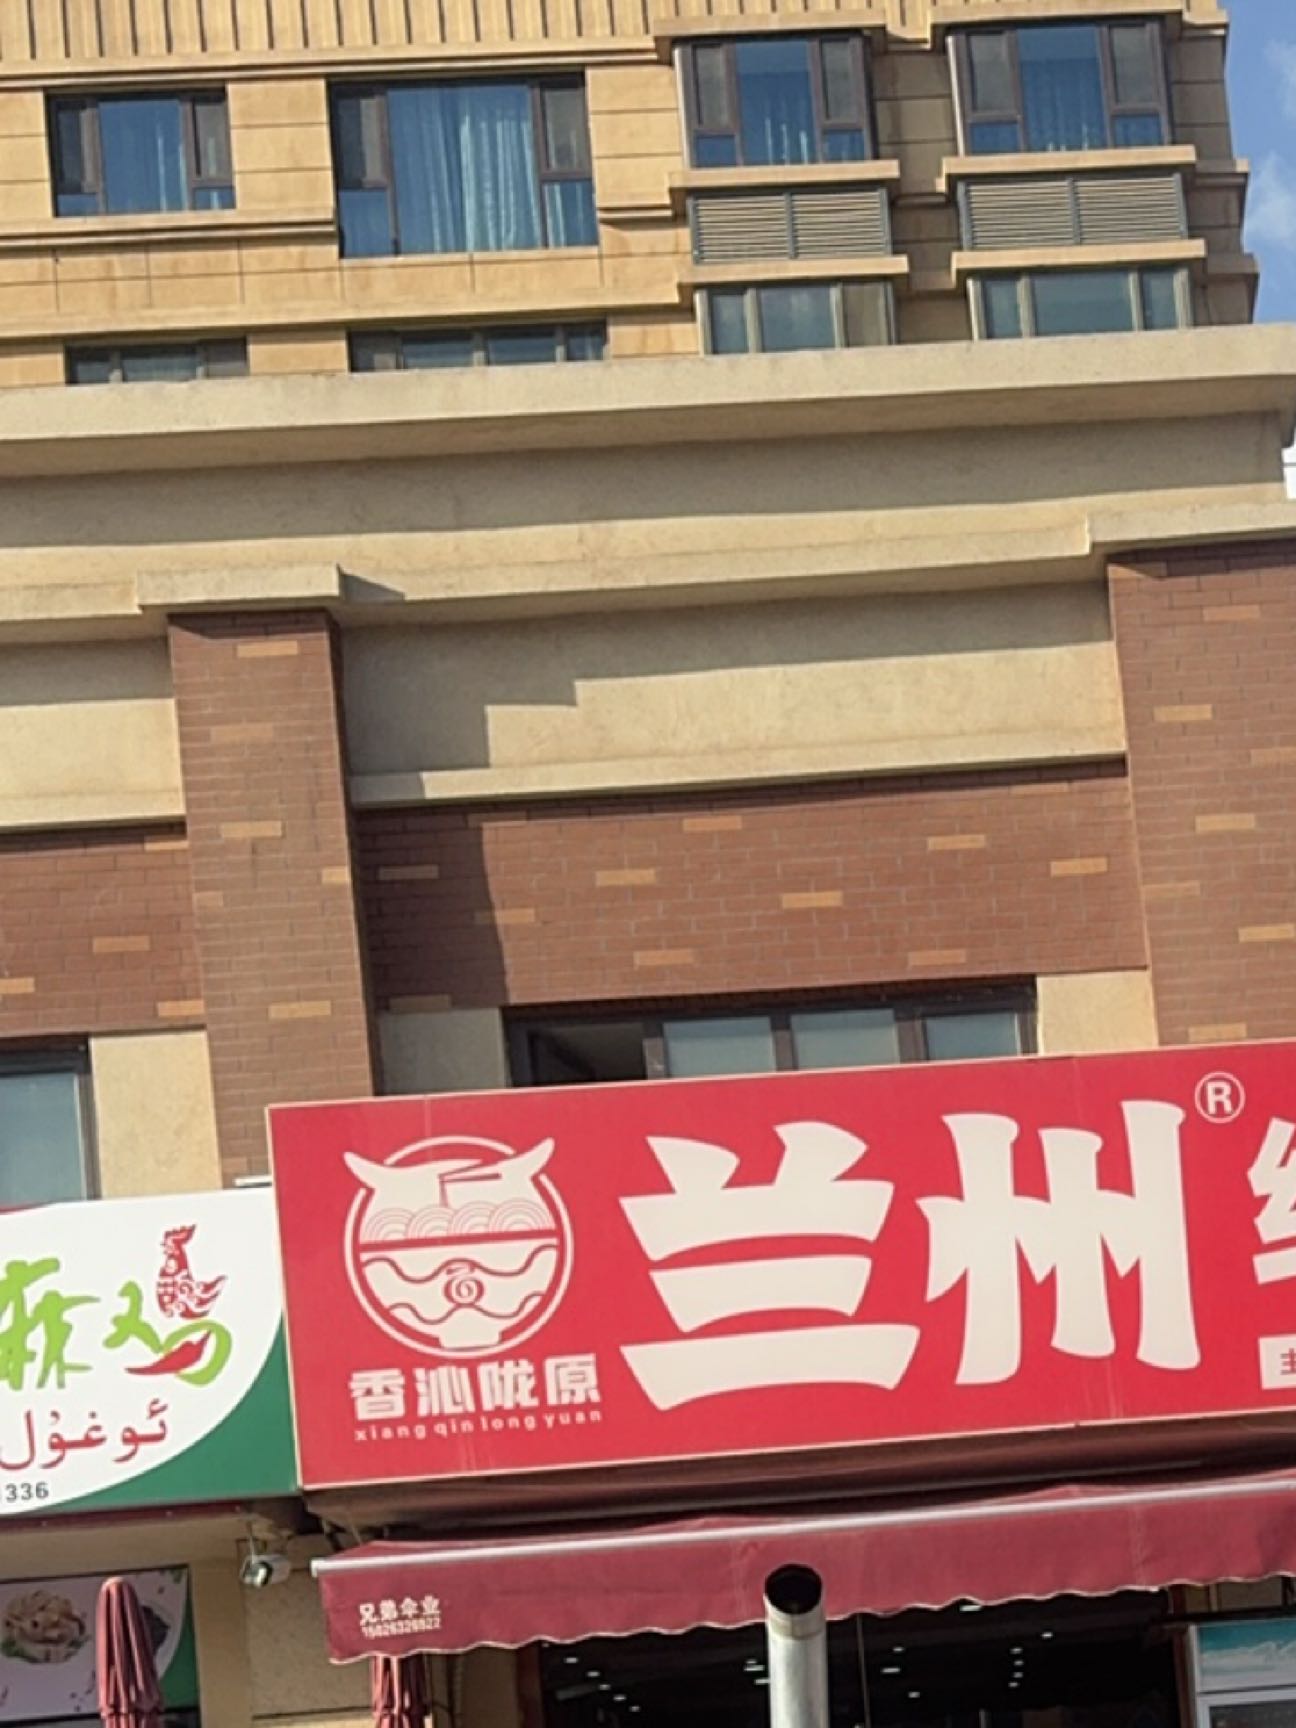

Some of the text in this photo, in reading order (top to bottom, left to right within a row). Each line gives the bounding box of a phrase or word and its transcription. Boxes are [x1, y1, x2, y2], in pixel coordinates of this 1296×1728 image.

[619, 1099, 1201, 1412] 兰州
[349, 1352, 602, 1421] 香沁陇原
